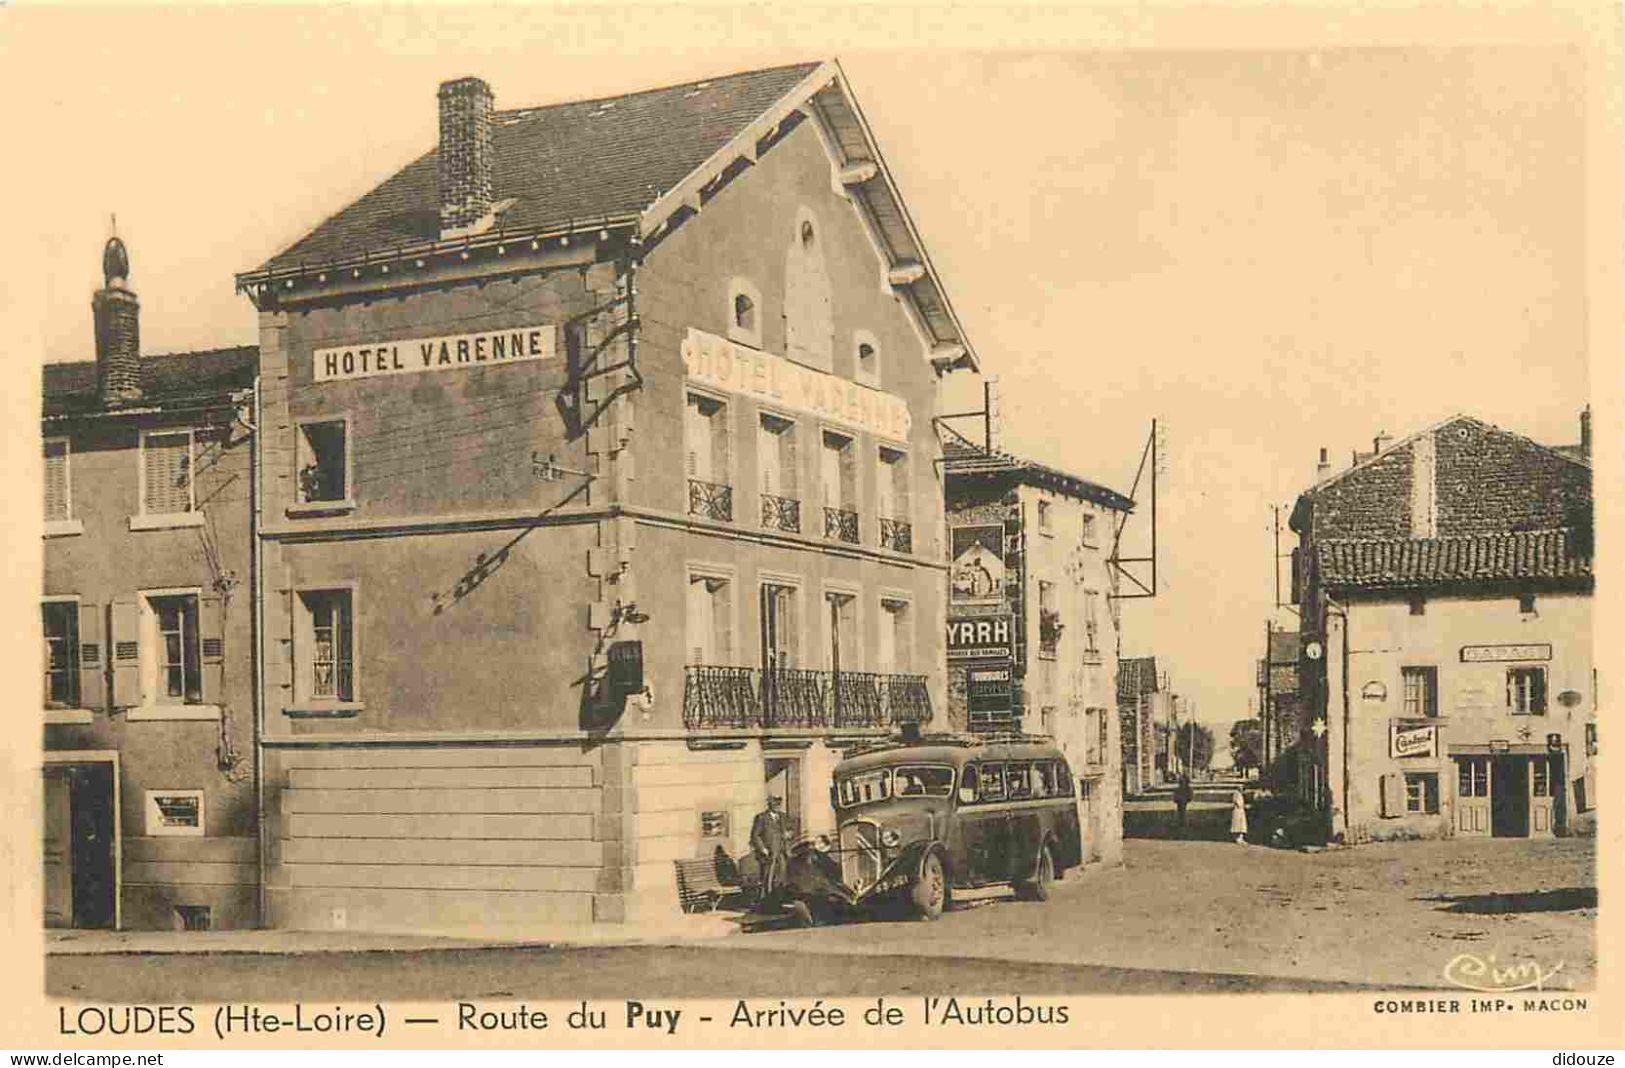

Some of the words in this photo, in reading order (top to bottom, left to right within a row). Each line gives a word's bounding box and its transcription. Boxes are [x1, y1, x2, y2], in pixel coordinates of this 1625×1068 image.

[325, 347, 404, 376] HOTEL
[421, 331, 542, 366] VARENNE
[695, 336, 782, 399] HOTEL
[798, 371, 903, 435] VARENNE
